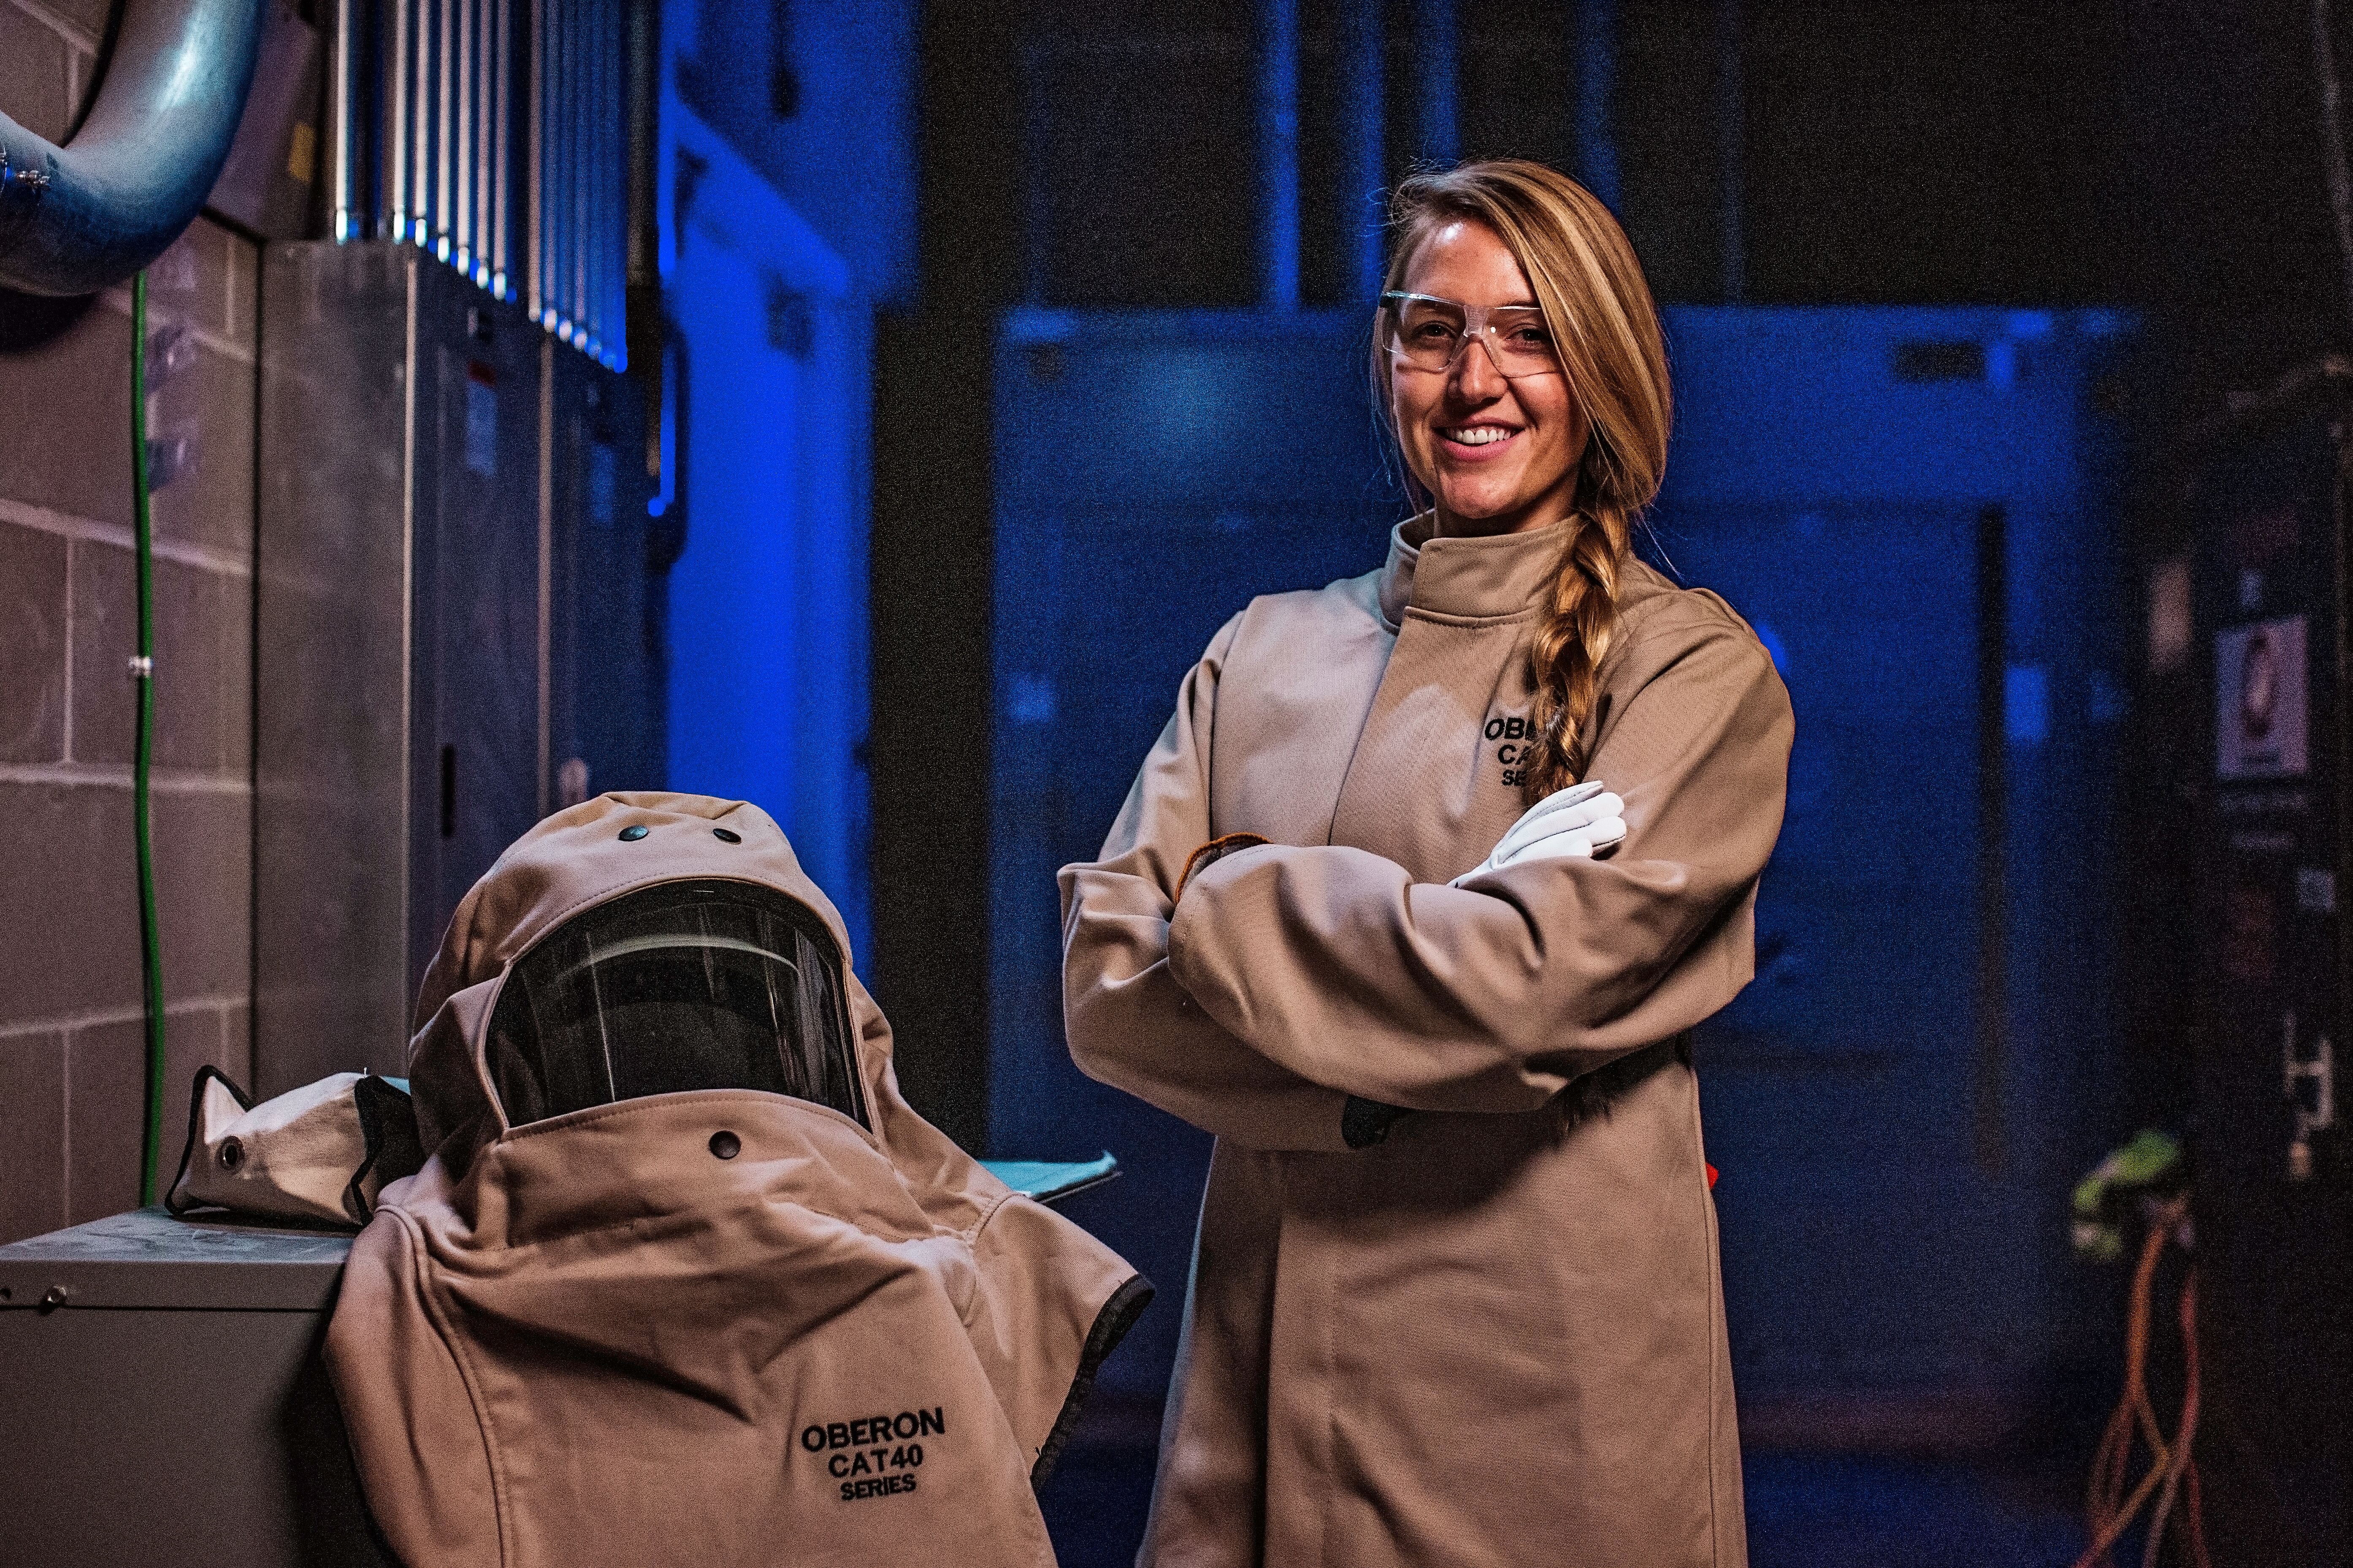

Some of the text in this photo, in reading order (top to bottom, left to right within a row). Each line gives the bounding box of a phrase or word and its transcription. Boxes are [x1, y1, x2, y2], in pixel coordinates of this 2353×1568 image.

[802, 1407, 945, 1452] OBERON
[829, 1444, 923, 1477] CAT40
[840, 1474, 916, 1500] SERIES
